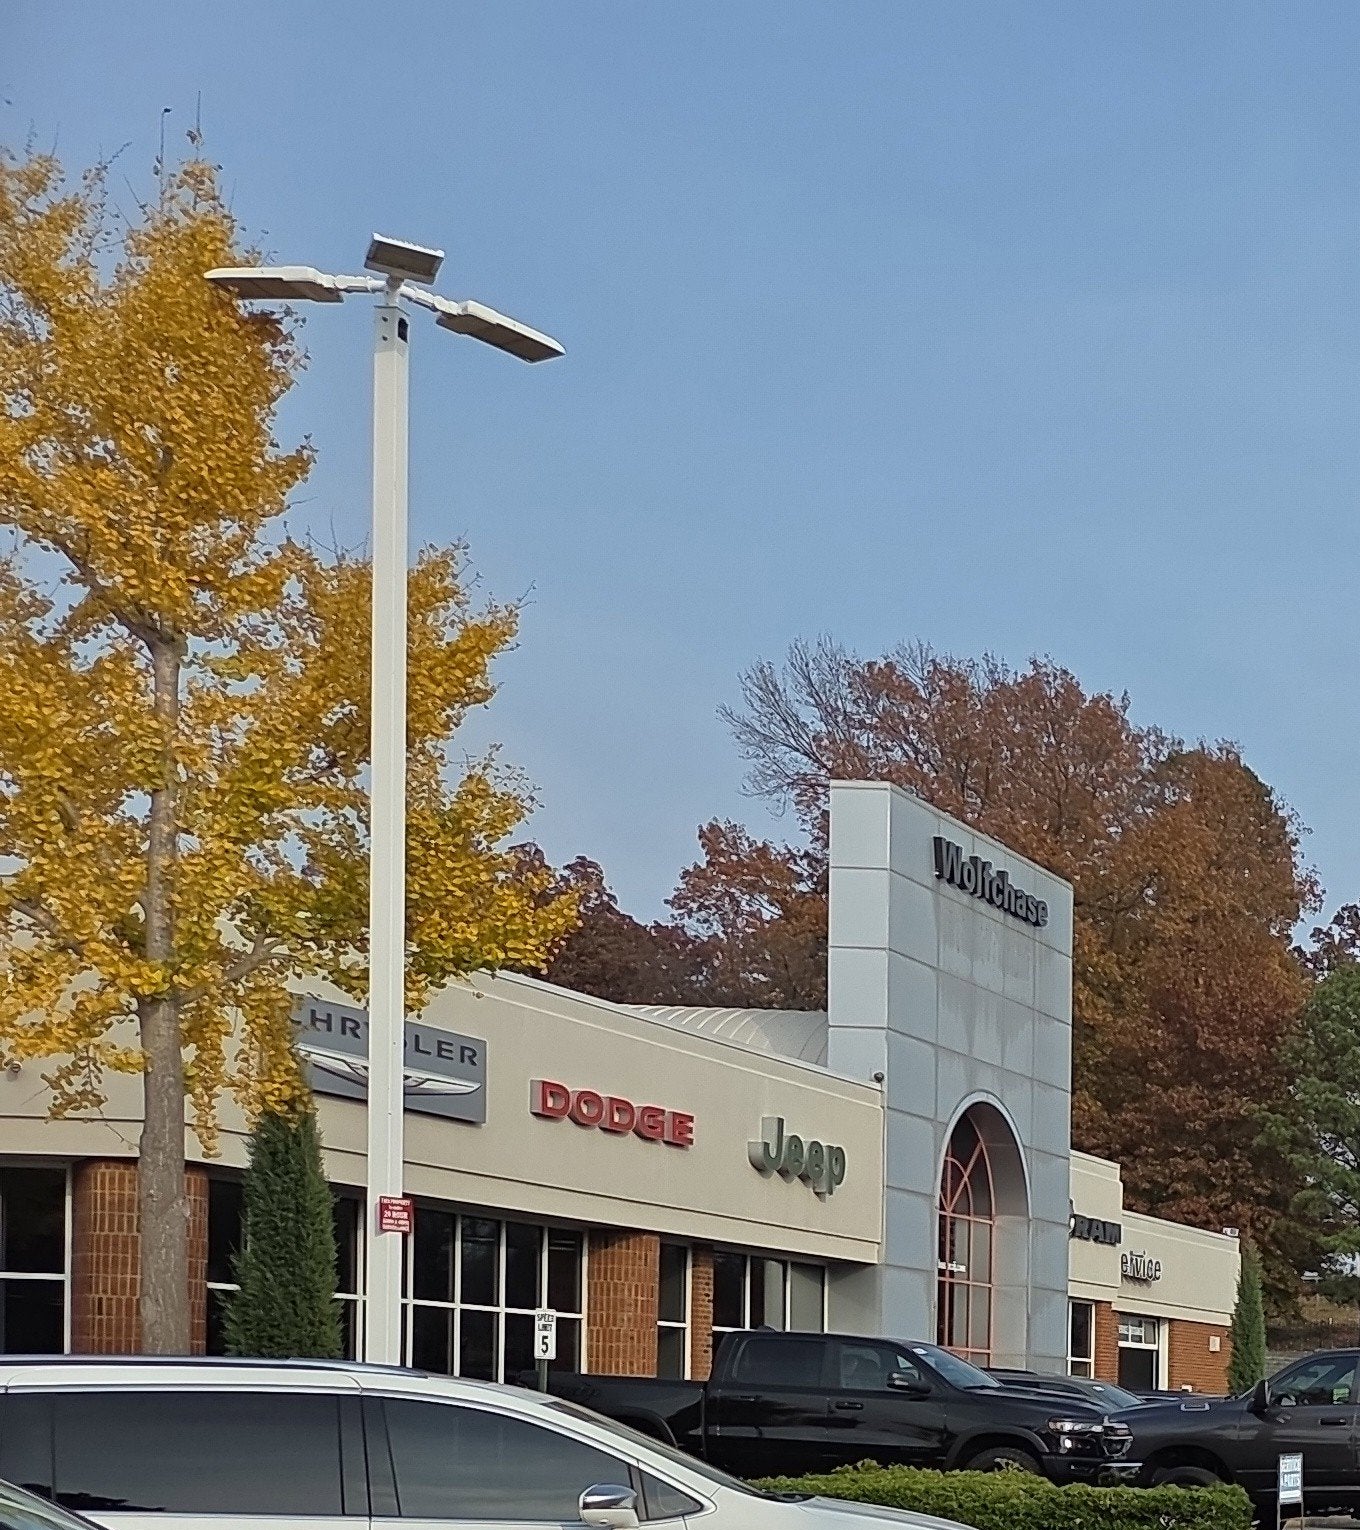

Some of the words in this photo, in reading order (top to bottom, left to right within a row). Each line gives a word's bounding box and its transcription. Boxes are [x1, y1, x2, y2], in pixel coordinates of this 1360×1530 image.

[933, 836, 1049, 928] Wolfchase
[284, 1002, 478, 1067] HRLER
[531, 1079, 695, 1147] DODGE
[748, 1116, 846, 1196] Jeep
[1121, 1250, 1161, 1280] ervice
[541, 1335, 549, 1354] 5
